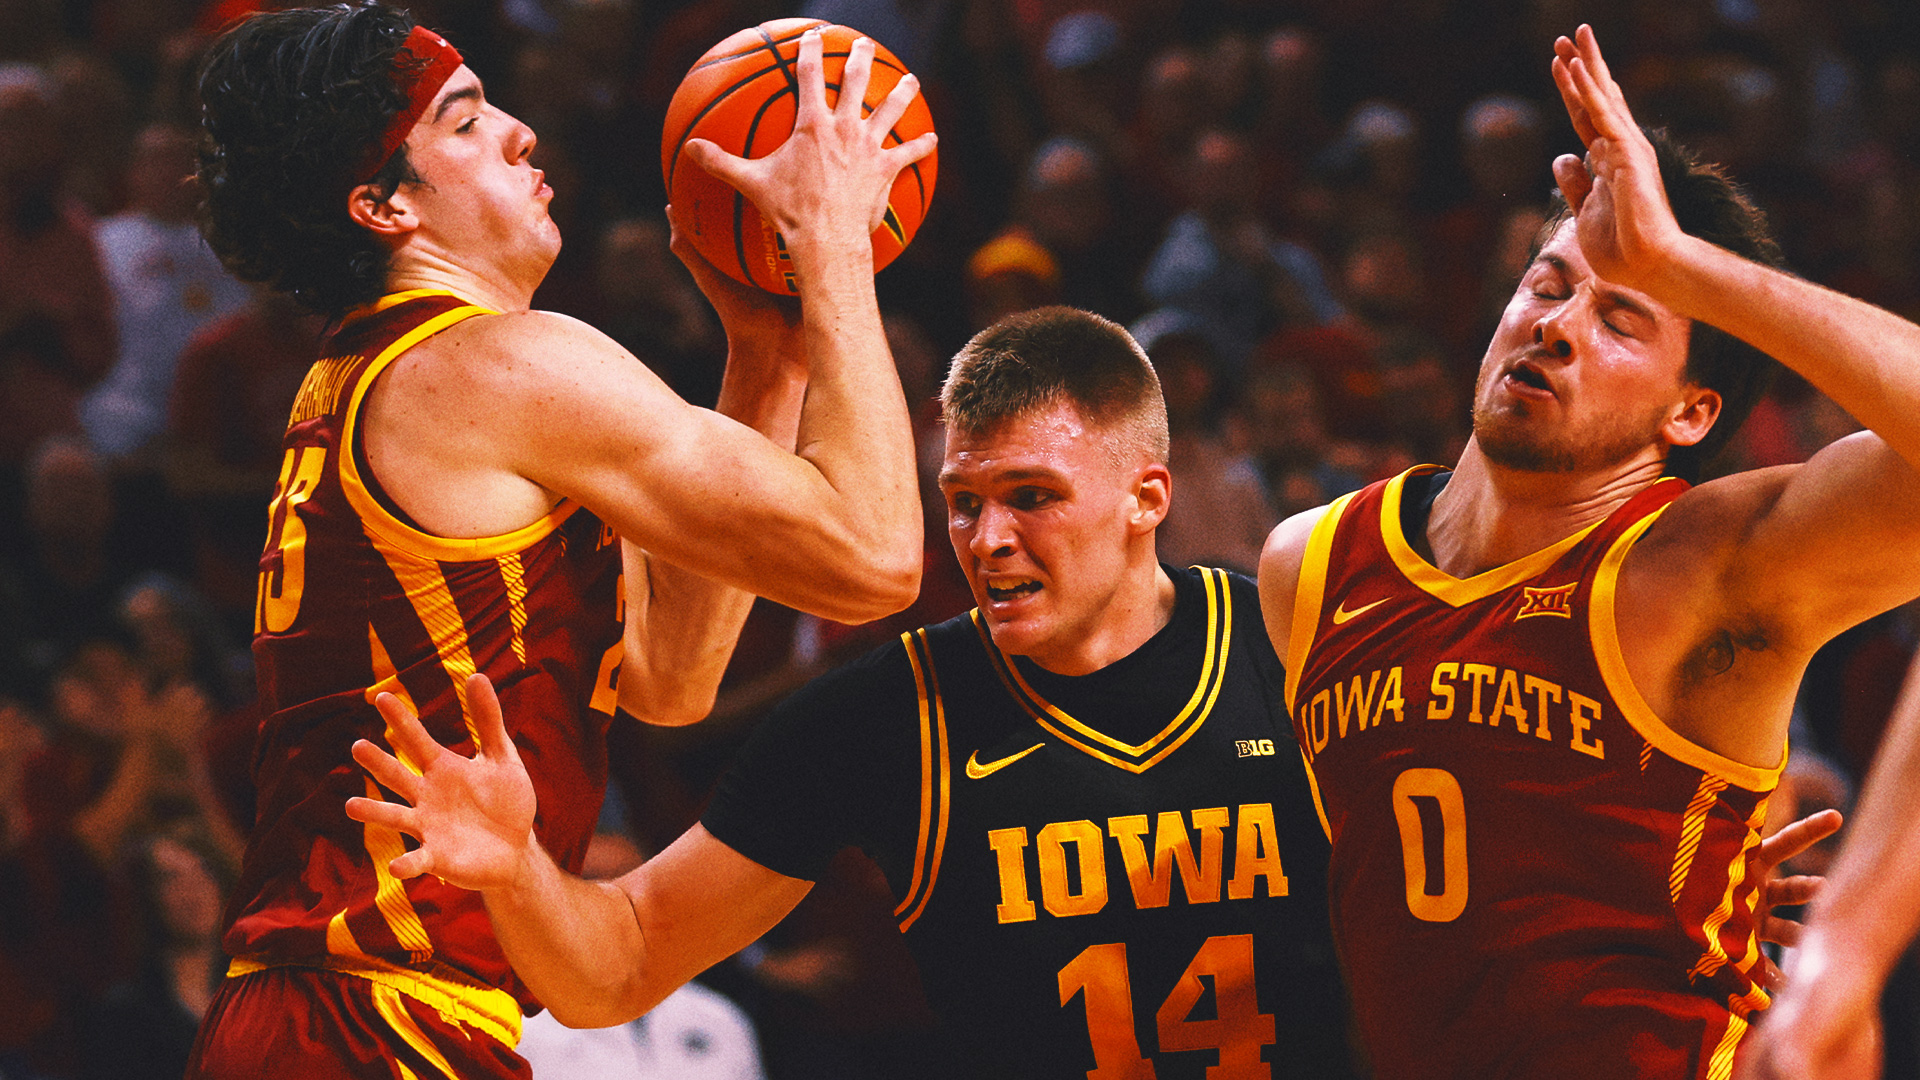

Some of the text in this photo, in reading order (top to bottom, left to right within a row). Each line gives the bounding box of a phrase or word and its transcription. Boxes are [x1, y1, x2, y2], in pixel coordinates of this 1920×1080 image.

[1518, 586, 1575, 617] XII
[1301, 662, 1606, 764] IOWA STATE
[987, 802, 1290, 925] IOWA
[1392, 767, 1469, 923] 0
[1057, 933, 1277, 1080] 14
